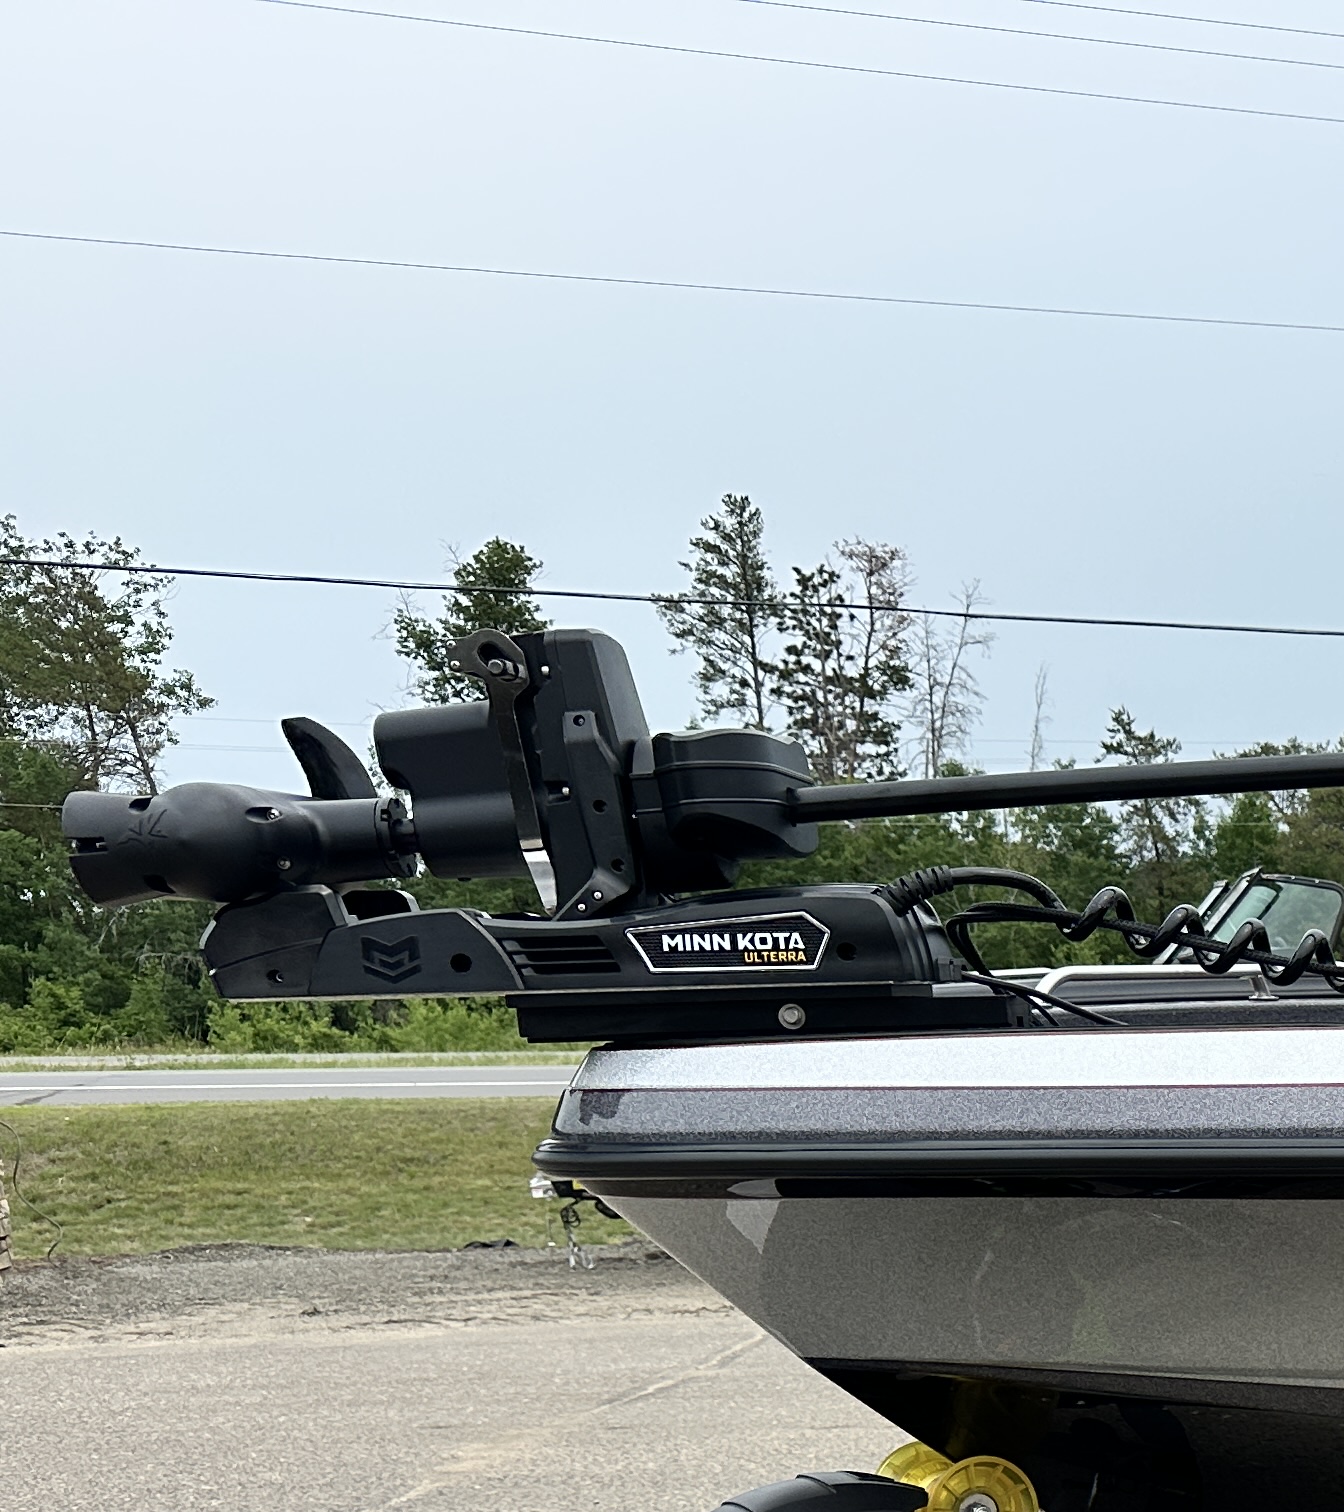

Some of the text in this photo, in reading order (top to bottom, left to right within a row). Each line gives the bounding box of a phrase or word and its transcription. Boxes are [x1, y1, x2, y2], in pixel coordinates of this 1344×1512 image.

[661, 932, 806, 951] MINN KOTA
[744, 951, 807, 963] ULTERRA
